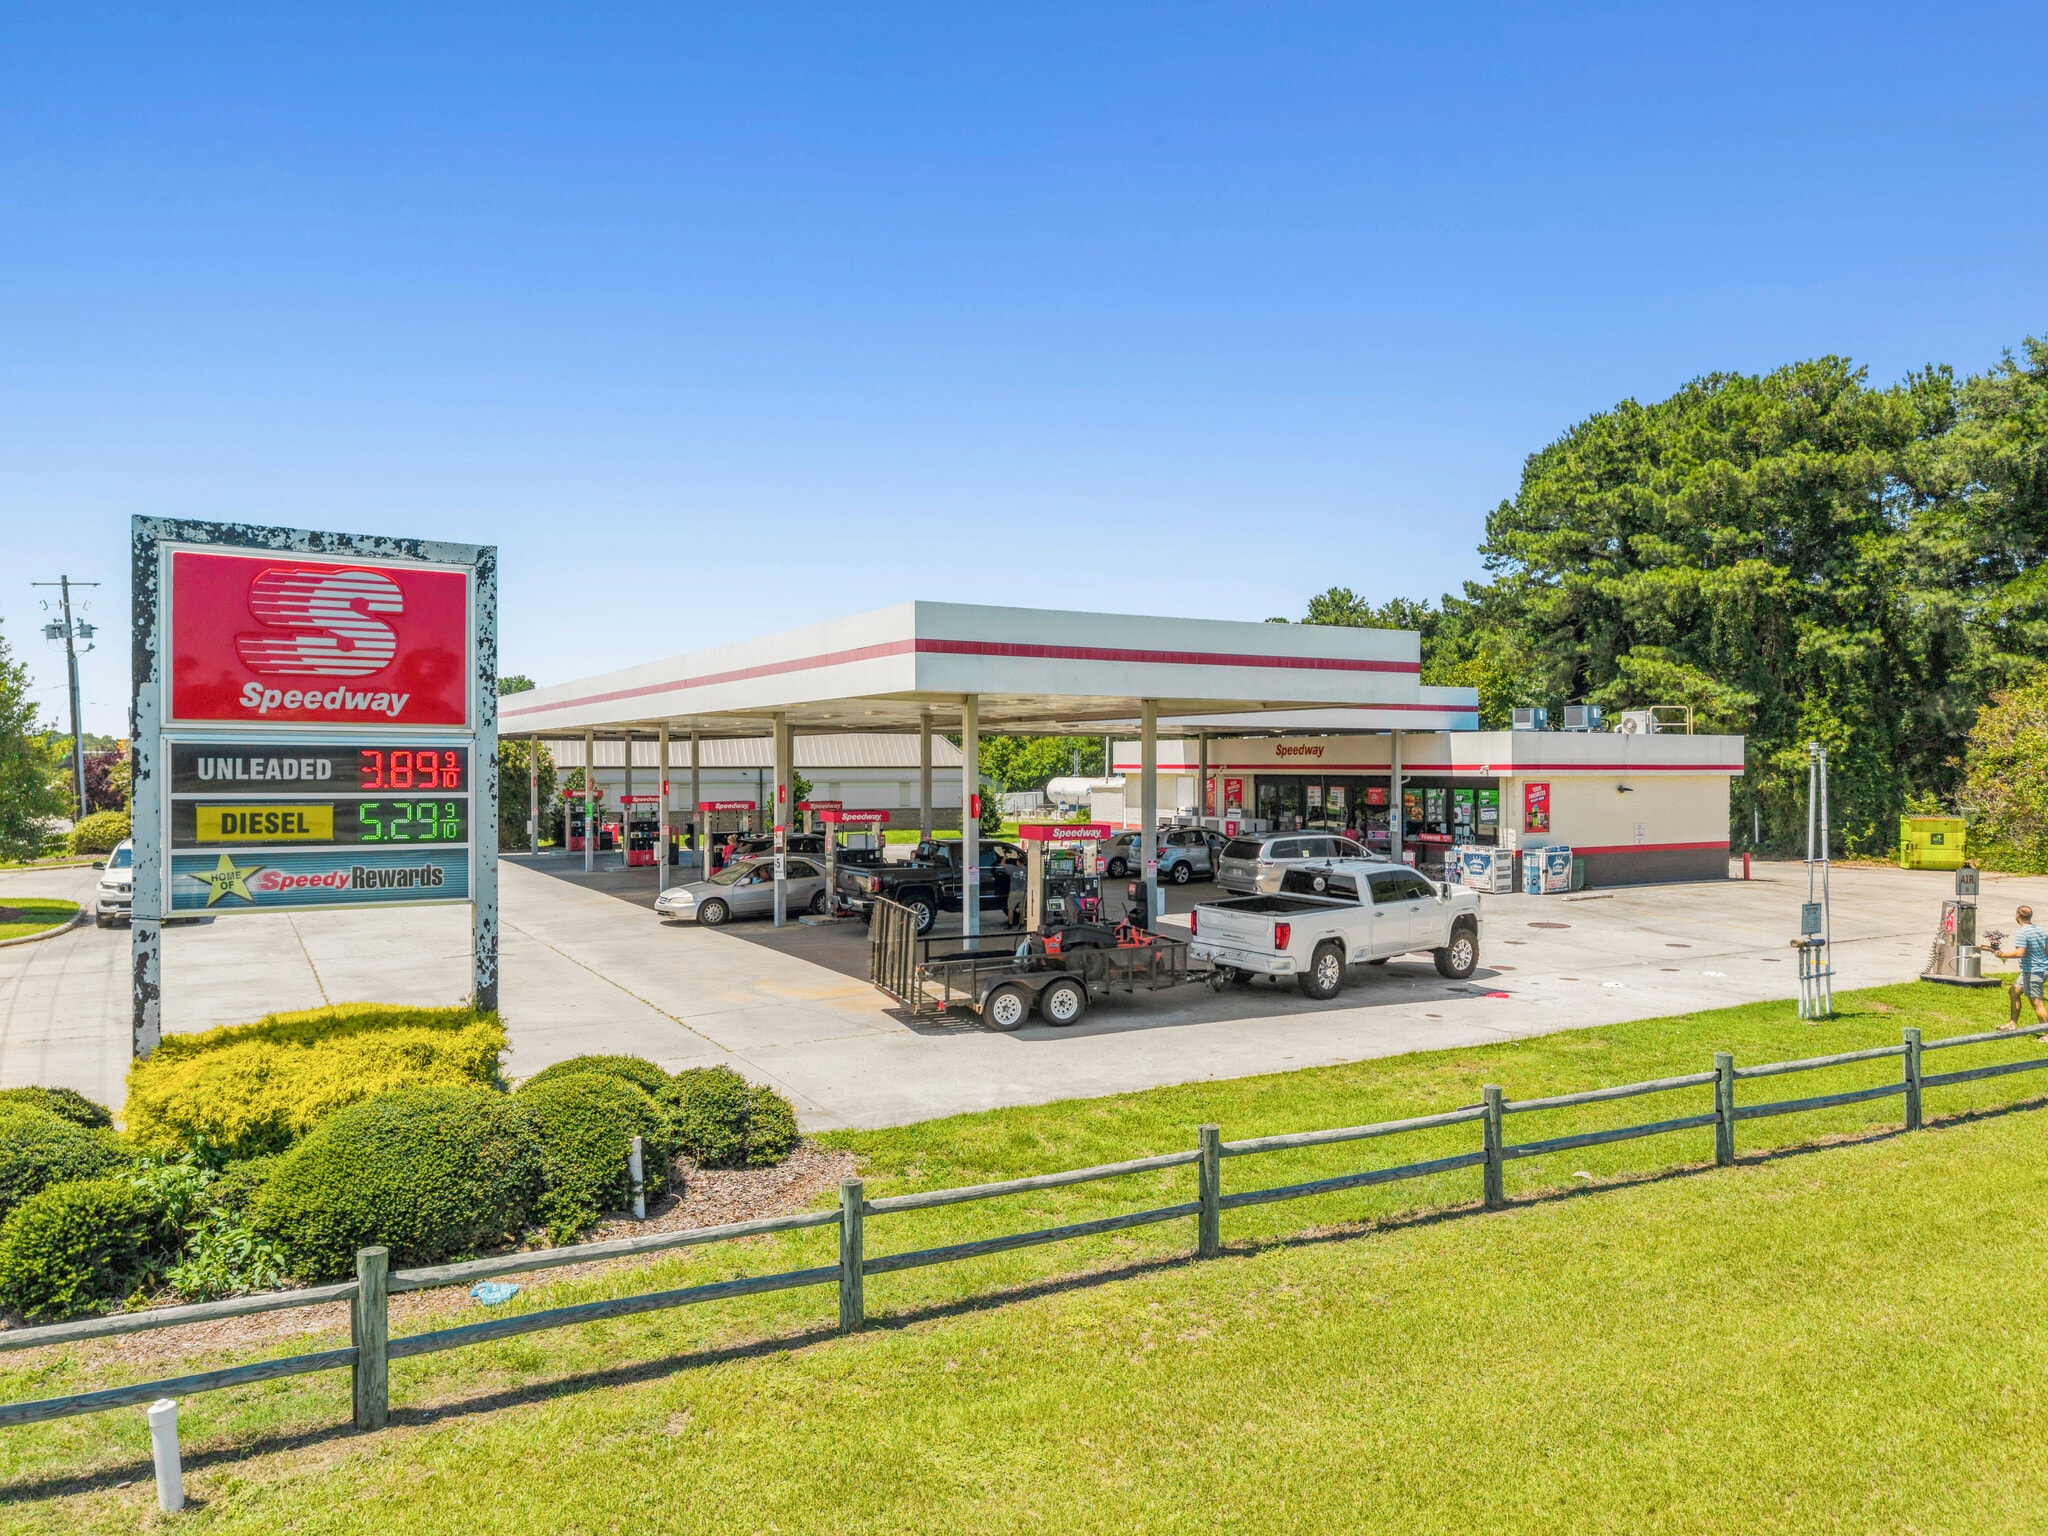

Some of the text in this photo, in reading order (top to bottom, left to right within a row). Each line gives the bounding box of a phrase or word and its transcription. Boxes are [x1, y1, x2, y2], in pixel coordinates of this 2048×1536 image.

[239, 682, 410, 717] Speedway
[1275, 744, 1325, 758] Speedway
[198, 750, 439, 788] UNLEADED 3.89
[221, 802, 438, 840] DIESEL 5.29
[841, 812, 882, 821] Speedway
[1052, 828, 1102, 839] Speedway
[211, 870, 242, 882] HOME
[259, 864, 443, 891] Speedy Rewards
[1960, 874, 1975, 884] AIR
[220, 880, 235, 891] OF
